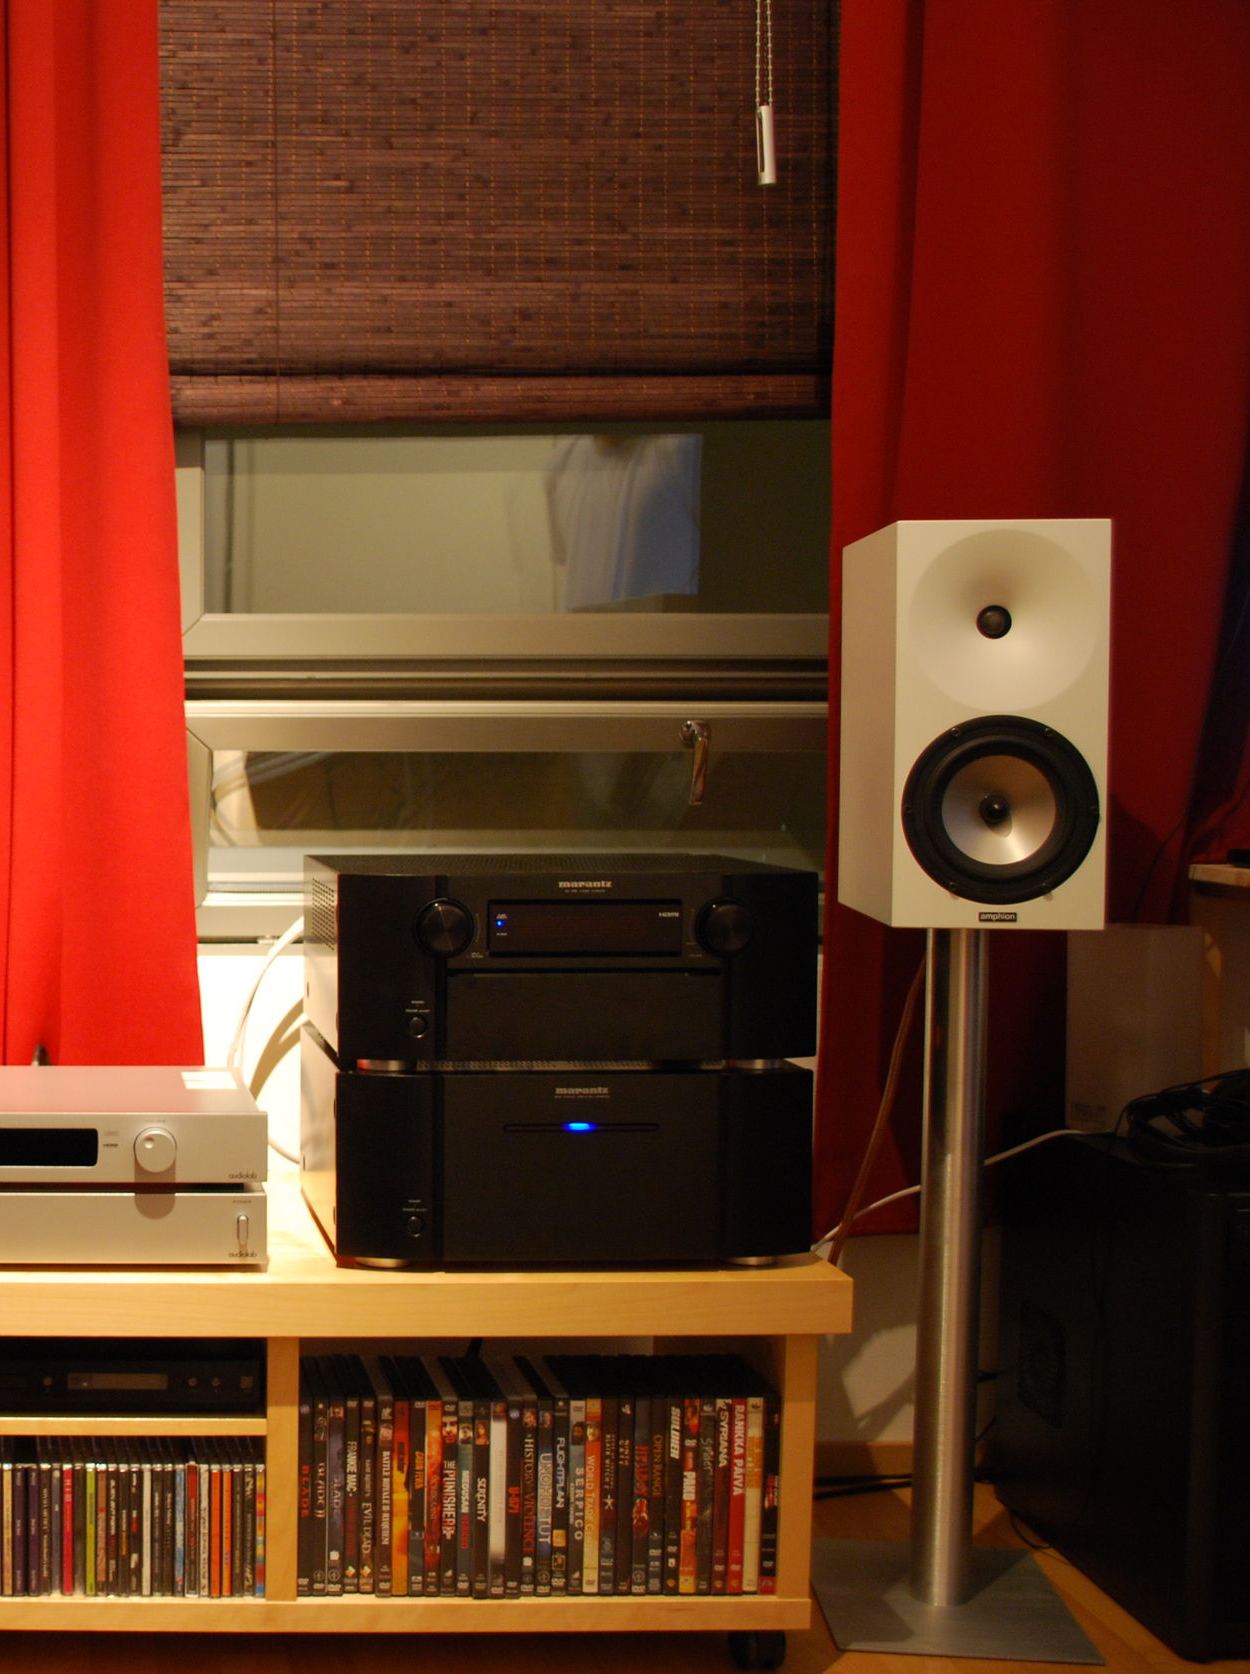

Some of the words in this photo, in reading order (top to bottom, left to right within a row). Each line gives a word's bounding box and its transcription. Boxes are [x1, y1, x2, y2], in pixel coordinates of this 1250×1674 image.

[558, 880, 613, 889] marantz
[980, 912, 1016, 921] amphion
[555, 1087, 609, 1095] marantz
[228, 1171, 258, 1179] audiolab
[670, 1406, 680, 1459] SOLDIER
[718, 1411, 729, 1467] SYRIANA
[734, 1405, 744, 1454] RANKKA
[382, 1451, 390, 1475] BATTLE
[653, 1434, 663, 1462] OPEN
[347, 1474, 356, 1492] MAC
[556, 1437, 565, 1508] FLIGHTPLAN
[586, 1455, 595, 1489] WORLD
[652, 1464, 662, 1496] RANGE
[683, 1471, 696, 1501] PAKO
[301, 1465, 309, 1518] BLADE
[442, 1470, 456, 1526] PUNISHER
[476, 1477, 486, 1522] SERENITY
[575, 1467, 584, 1540] SERPICO
[362, 1502, 372, 1526] EVIL
[524, 1492, 535, 1553] VIOLENCE
